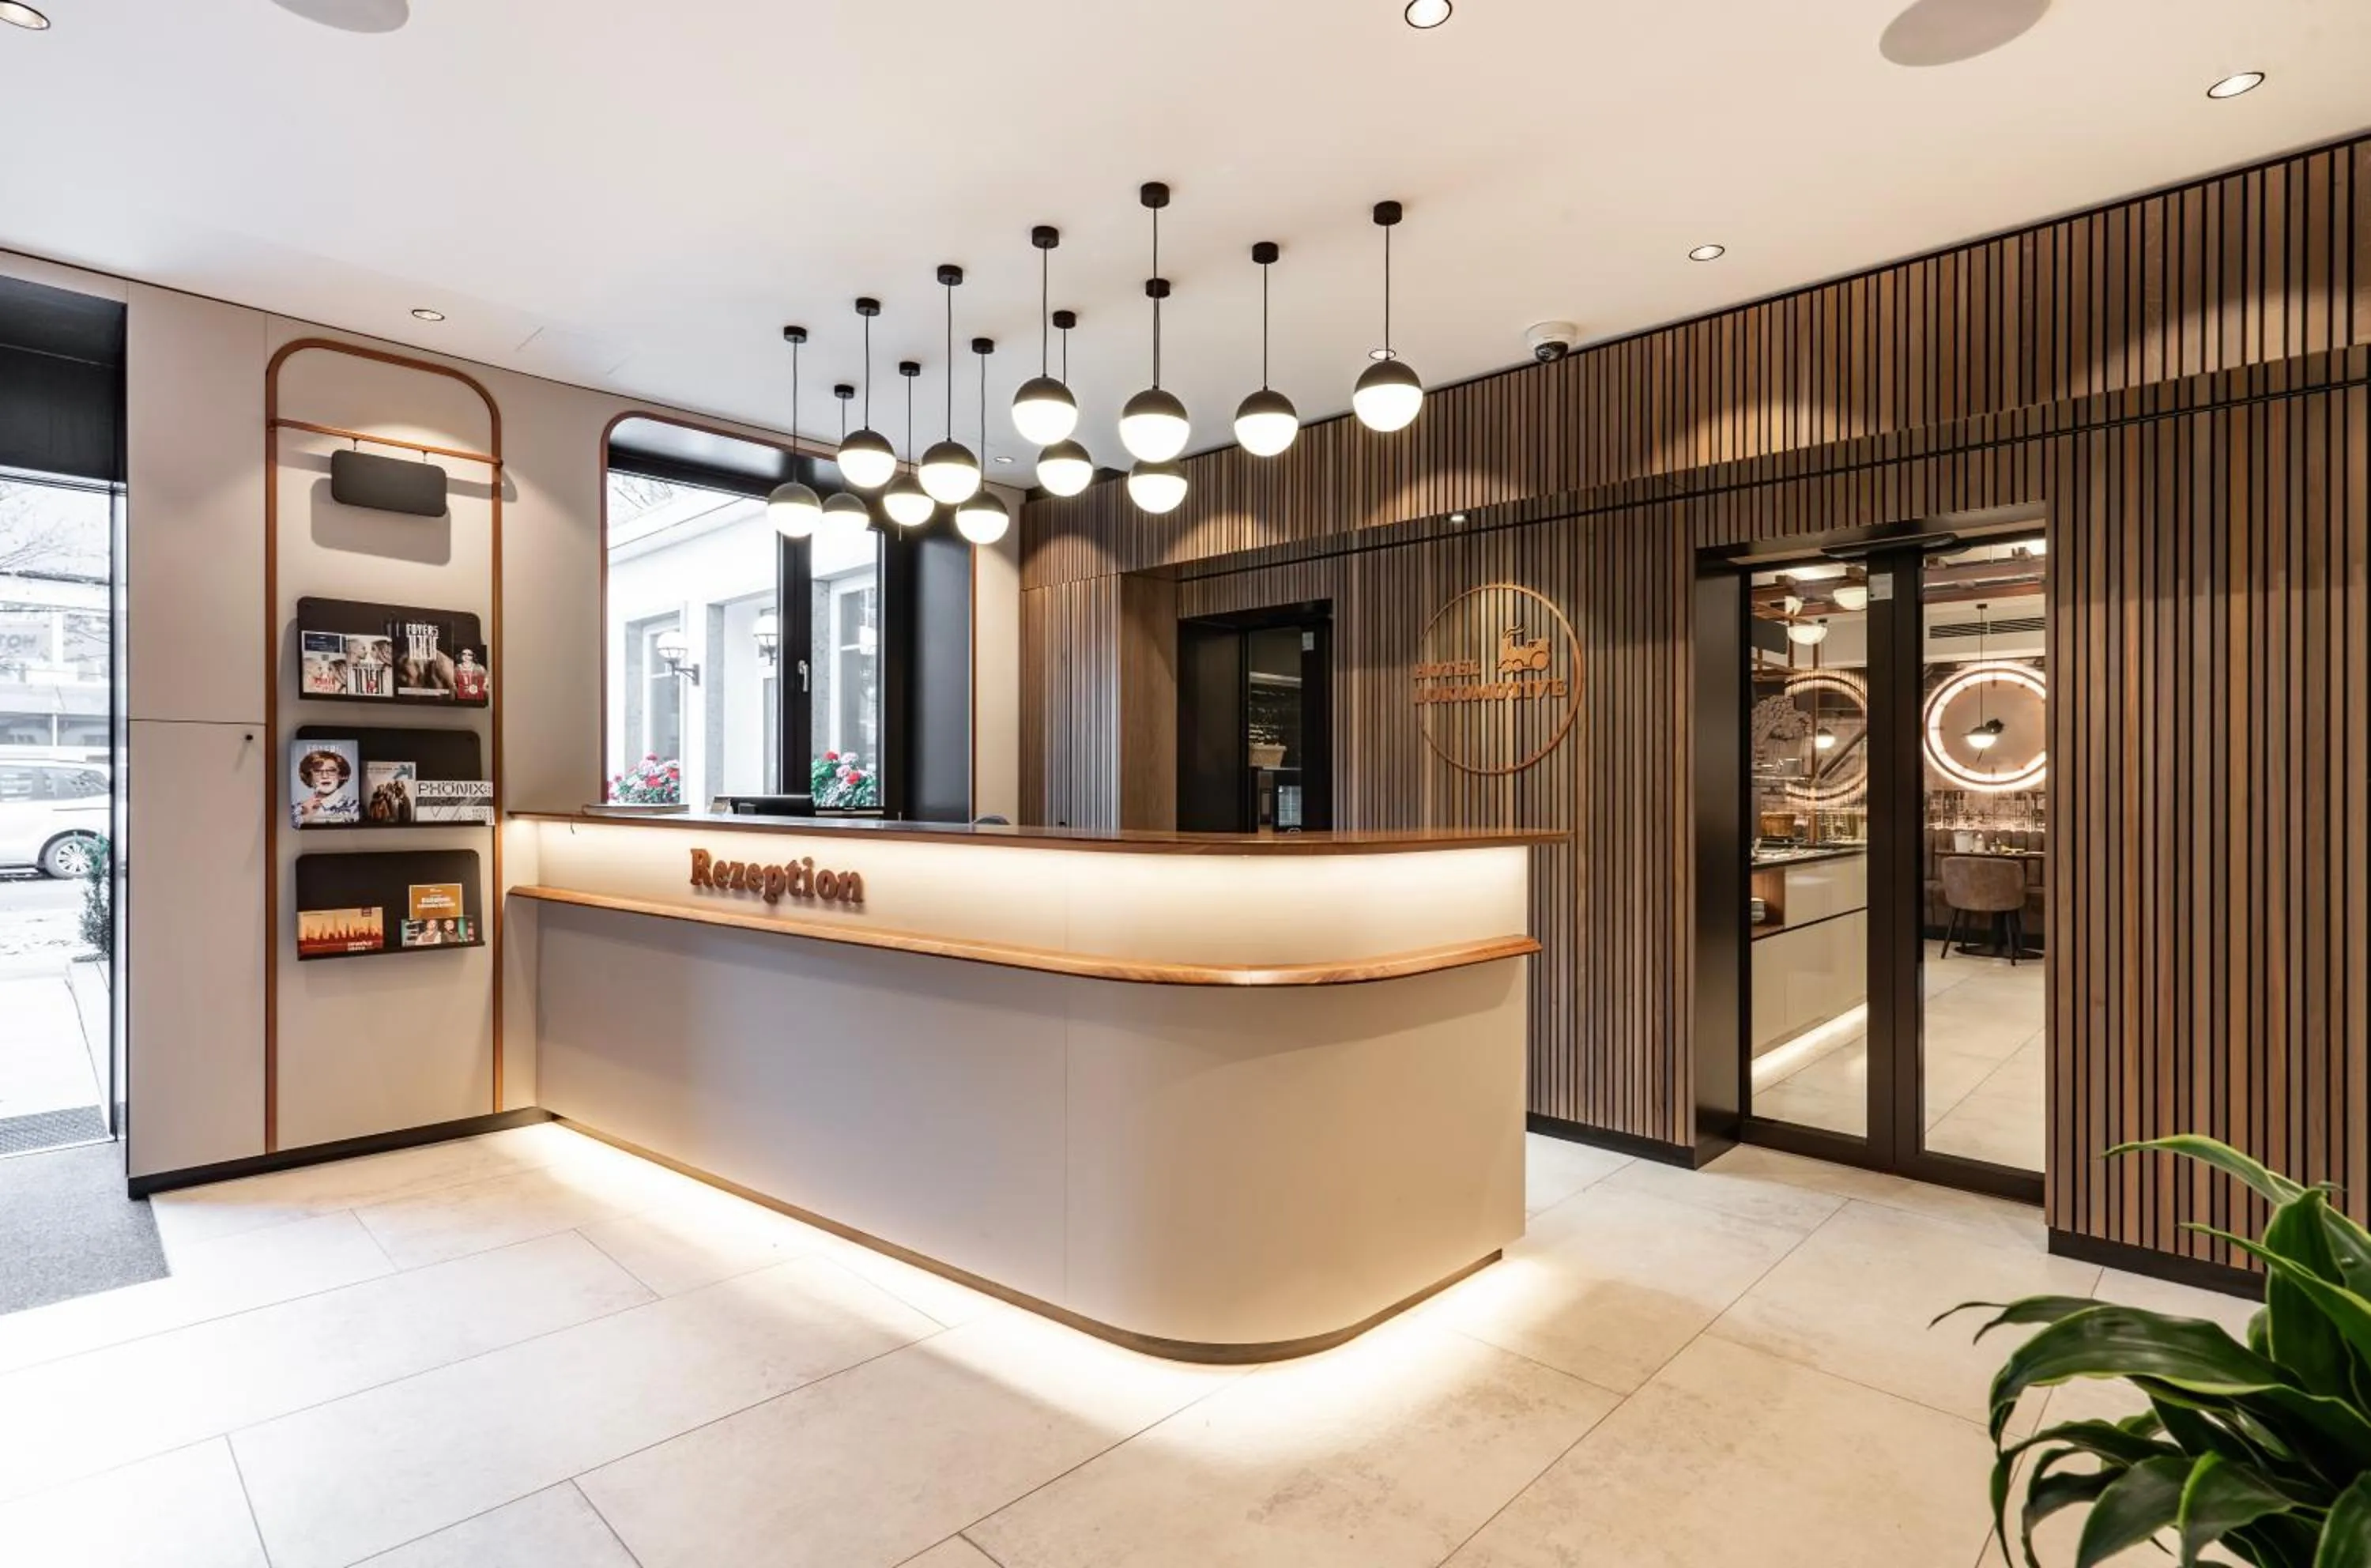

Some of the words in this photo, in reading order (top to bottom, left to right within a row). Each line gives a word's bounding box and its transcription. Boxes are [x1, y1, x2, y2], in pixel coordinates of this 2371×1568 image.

[1414, 660, 1480, 679] HOTEL
[1414, 678, 1568, 705] LOKOMOTIVE
[418, 781, 484, 796] PHÖNIX
[690, 848, 864, 904] Rezeption
